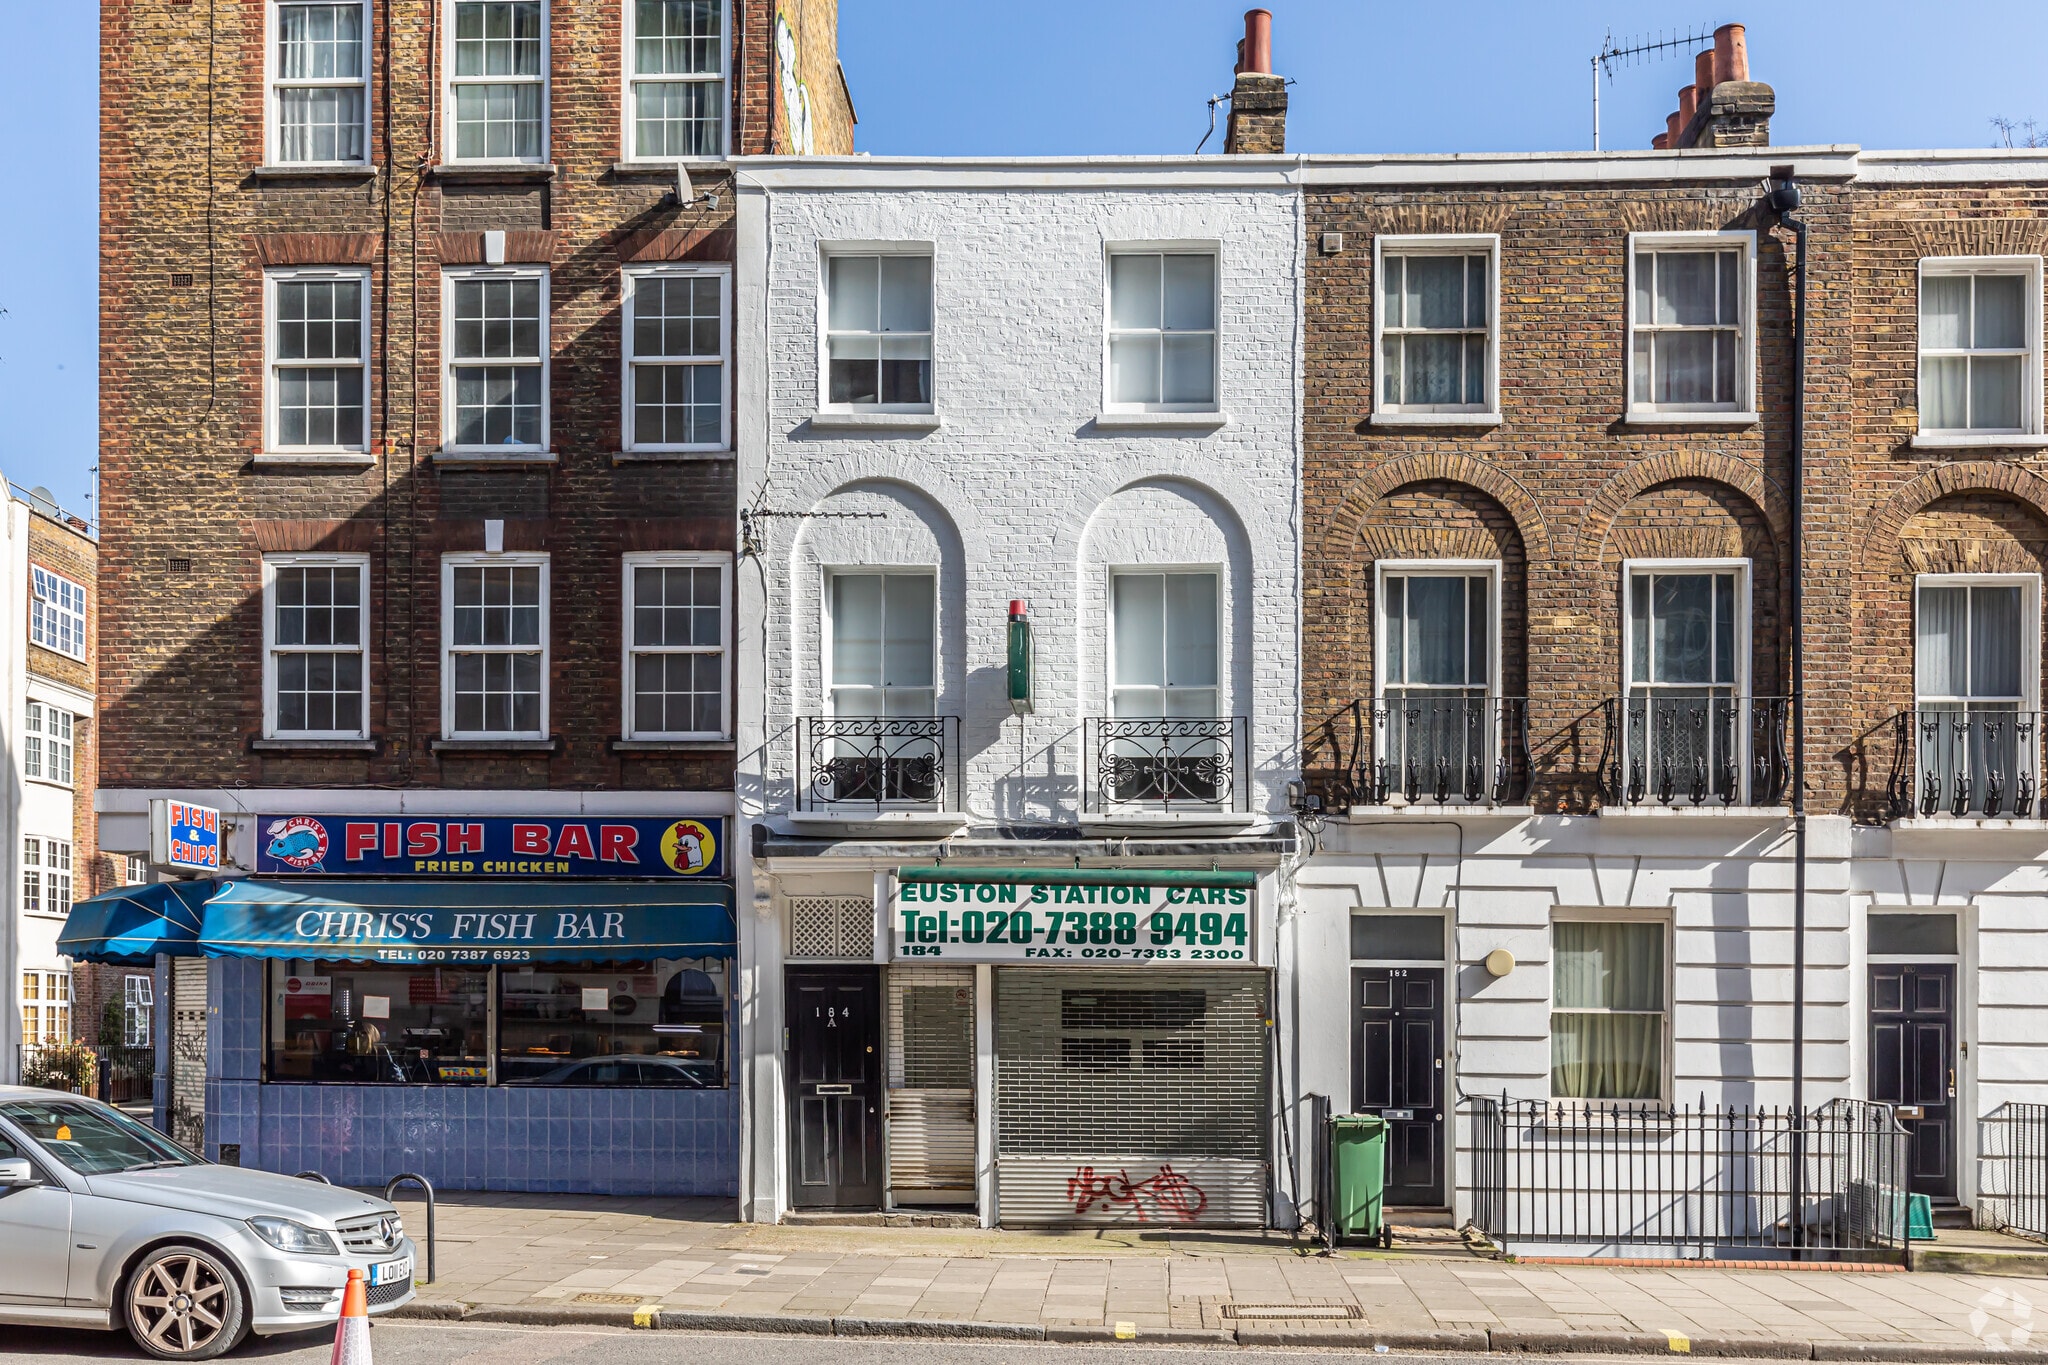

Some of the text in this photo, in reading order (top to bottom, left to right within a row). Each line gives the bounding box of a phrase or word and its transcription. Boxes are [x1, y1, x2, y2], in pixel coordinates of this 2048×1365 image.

[171, 804, 216, 833] FISH
[288, 818, 326, 839] CHRIS'S
[189, 829, 200, 841] &
[345, 822, 640, 864] FISH BAR
[171, 839, 217, 866] CHIPS
[288, 846, 326, 867] FISH BAR
[414, 860, 570, 874] FRIED CHICKEN
[900, 882, 1248, 905] EUSTON STATION CARS
[295, 910, 625, 940] CHRIS'S FISH BAR
[1149, 911, 1249, 947] 9494
[377, 949, 531, 961] TEL: 020 7387 6923
[900, 944, 1245, 960] 184 FAX: 020-7383 2300
[1389, 969, 1408, 977] 182
[816, 1006, 849, 1017] 184
[826, 1017, 837, 1028] A
